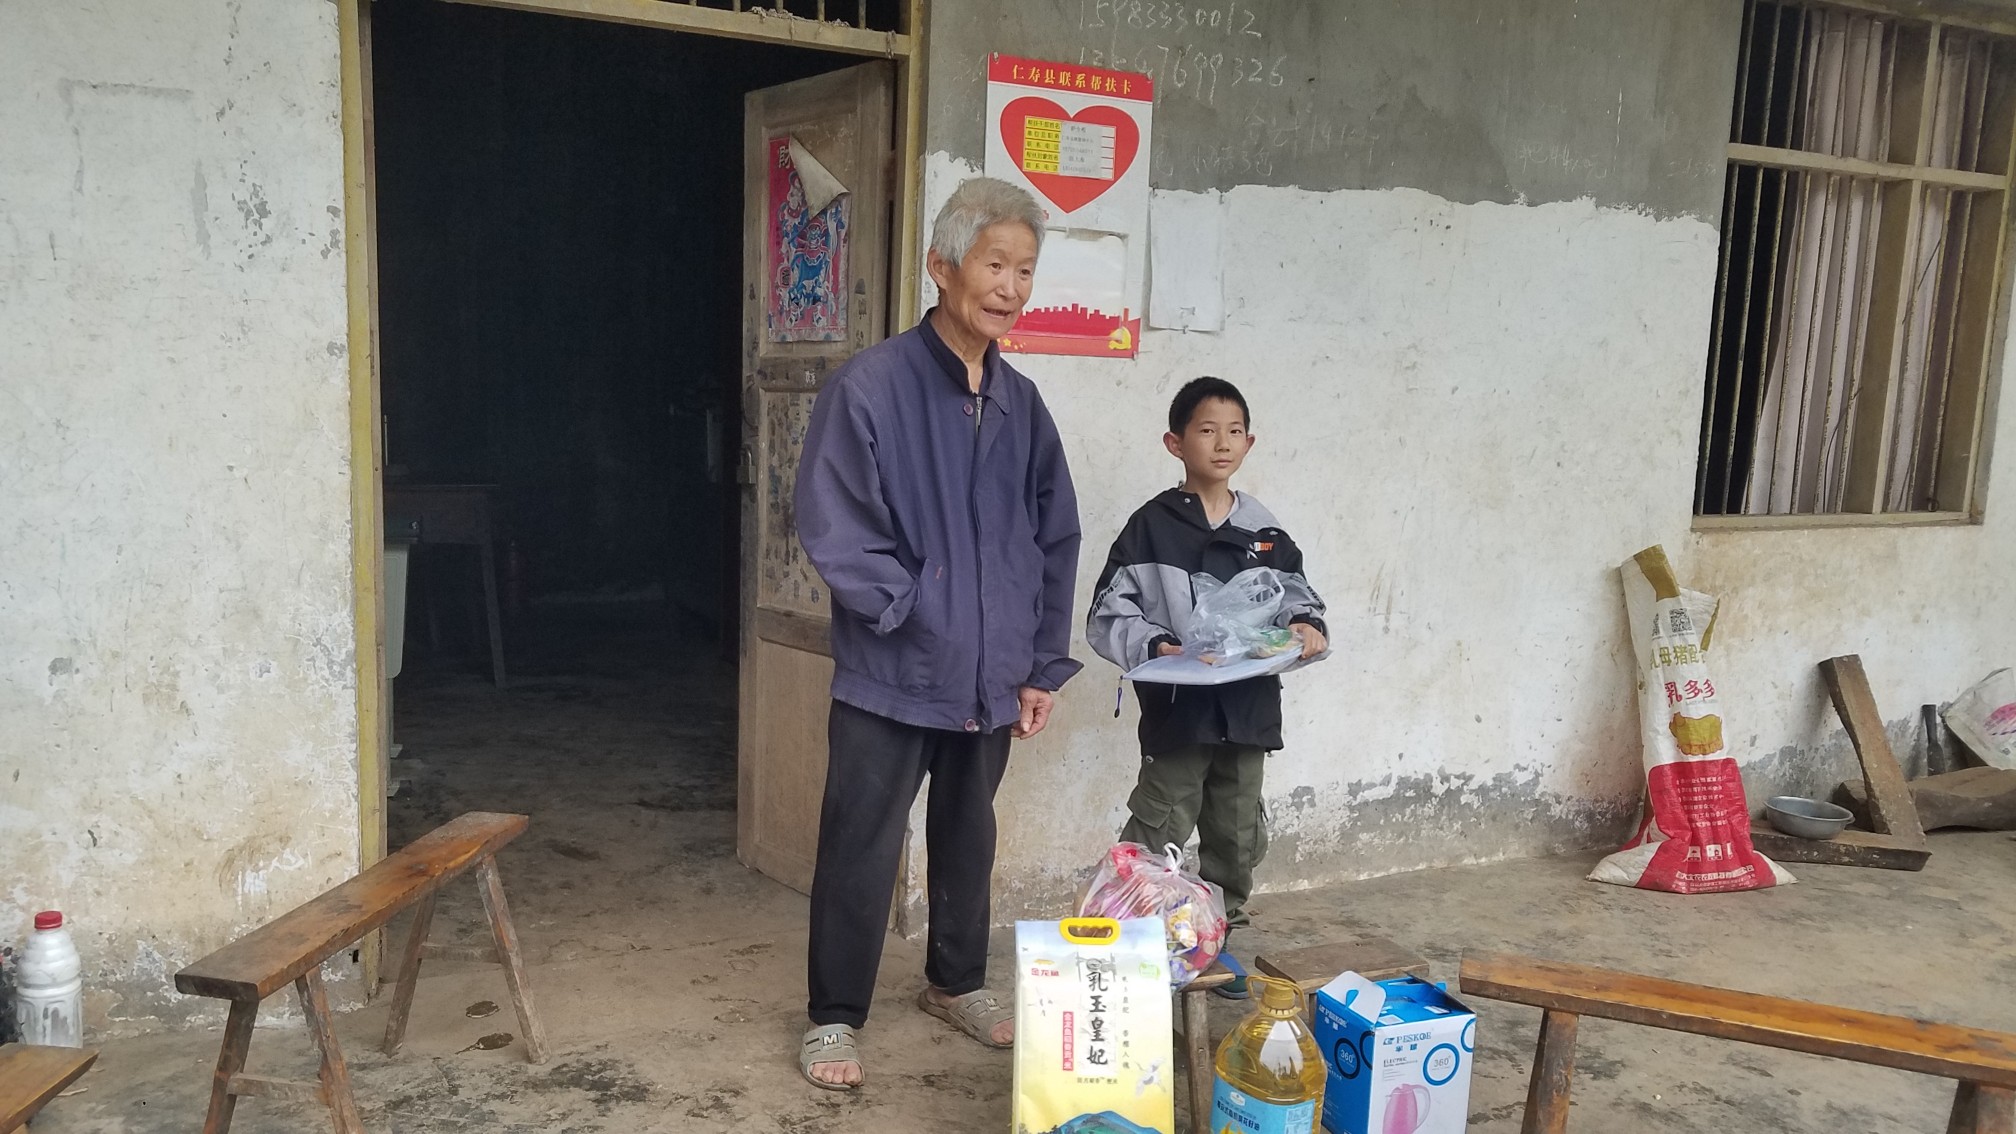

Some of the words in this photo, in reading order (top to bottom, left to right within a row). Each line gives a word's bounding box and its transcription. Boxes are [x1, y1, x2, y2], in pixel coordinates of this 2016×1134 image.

[1012, 64, 1132, 95] 仁寿县联系帮扶卡
[1031, 967, 1060, 977] 金龙鱼
[1086, 971, 1109, 1066] 乳玉皇妃
[823, 1033, 839, 1046] M
